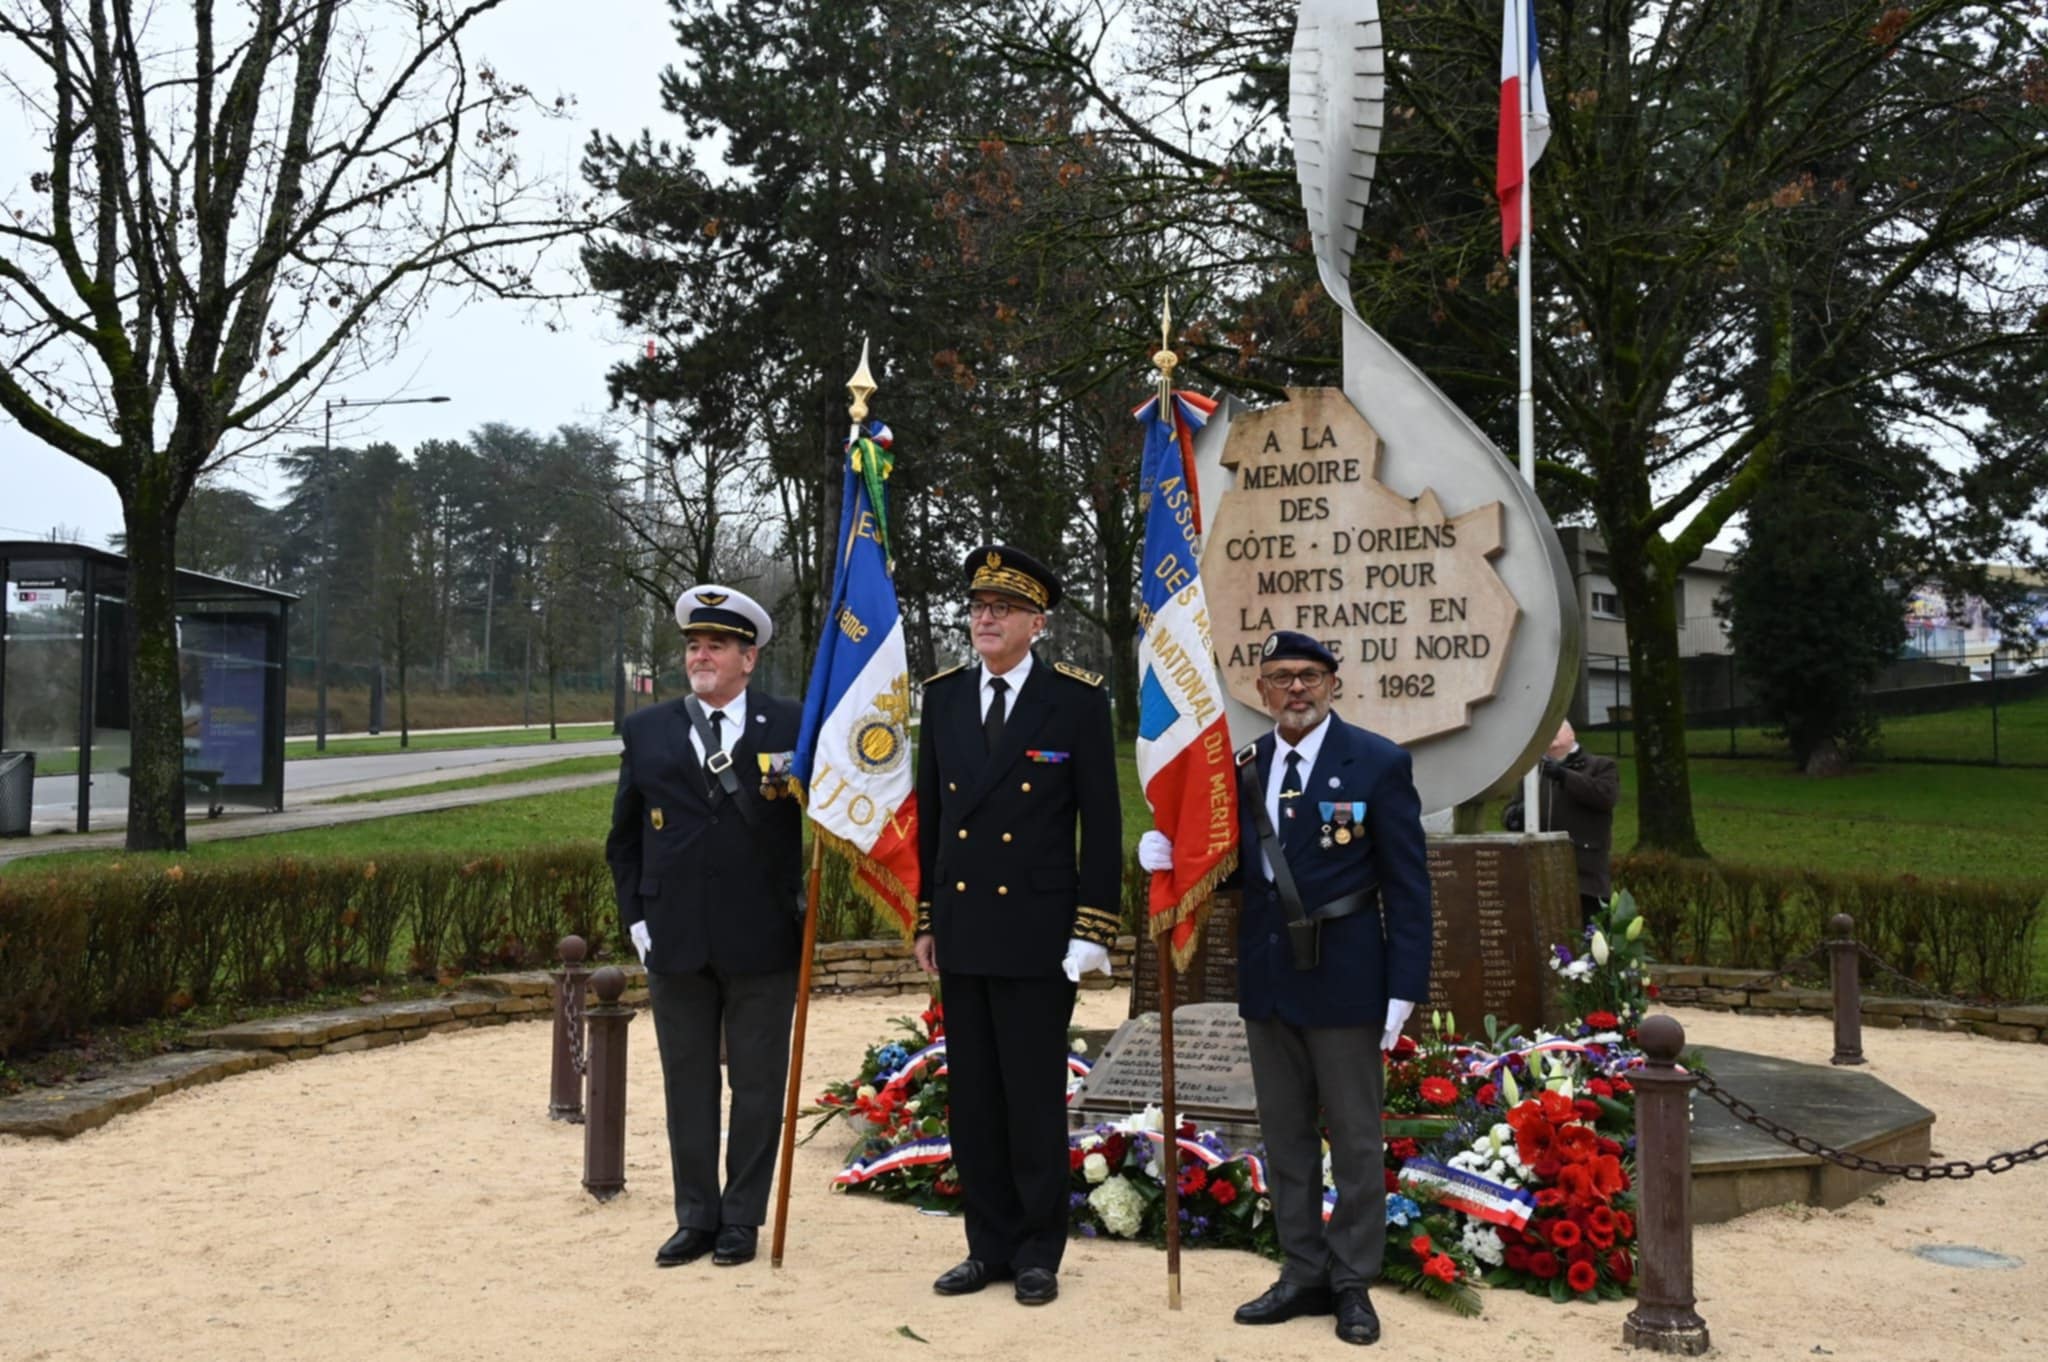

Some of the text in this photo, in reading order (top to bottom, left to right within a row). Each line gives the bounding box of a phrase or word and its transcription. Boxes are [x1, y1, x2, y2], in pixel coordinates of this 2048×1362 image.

[1262, 425, 1338, 454] A LA
[1243, 458, 1360, 490] MEMOIRE
[1280, 497, 1330, 522] DES
[1155, 553, 1198, 607] DES
[1257, 562, 1437, 595] MORTS POUR
[1240, 597, 1467, 631] LA FRANCE EN
[1361, 637, 1397, 662] DU
[1415, 634, 1491, 660] NORD
[1151, 628, 1216, 728] NATIONAL
[1204, 732, 1224, 765] DU
[1379, 673, 1435, 698] 1962
